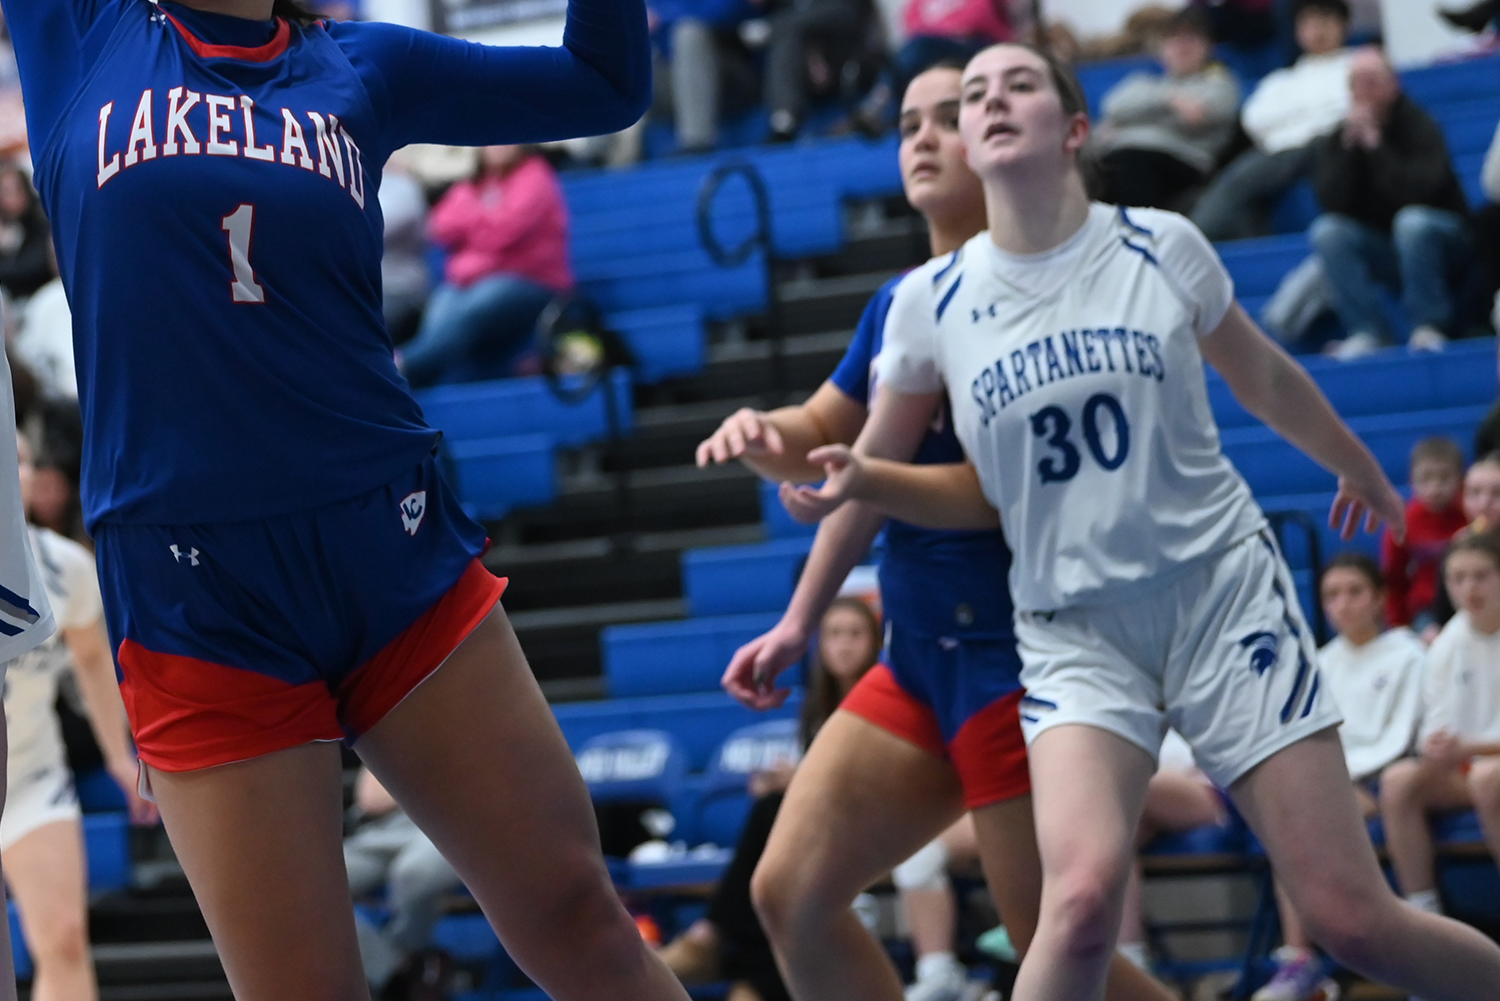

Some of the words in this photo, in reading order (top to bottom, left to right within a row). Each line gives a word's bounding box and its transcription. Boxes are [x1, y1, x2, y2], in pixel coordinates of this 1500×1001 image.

[97, 85, 365, 210] LAKELAND
[221, 203, 266, 303] 1
[971, 326, 1165, 427] SPARTANETTES
[1028, 391, 1131, 487] 30
